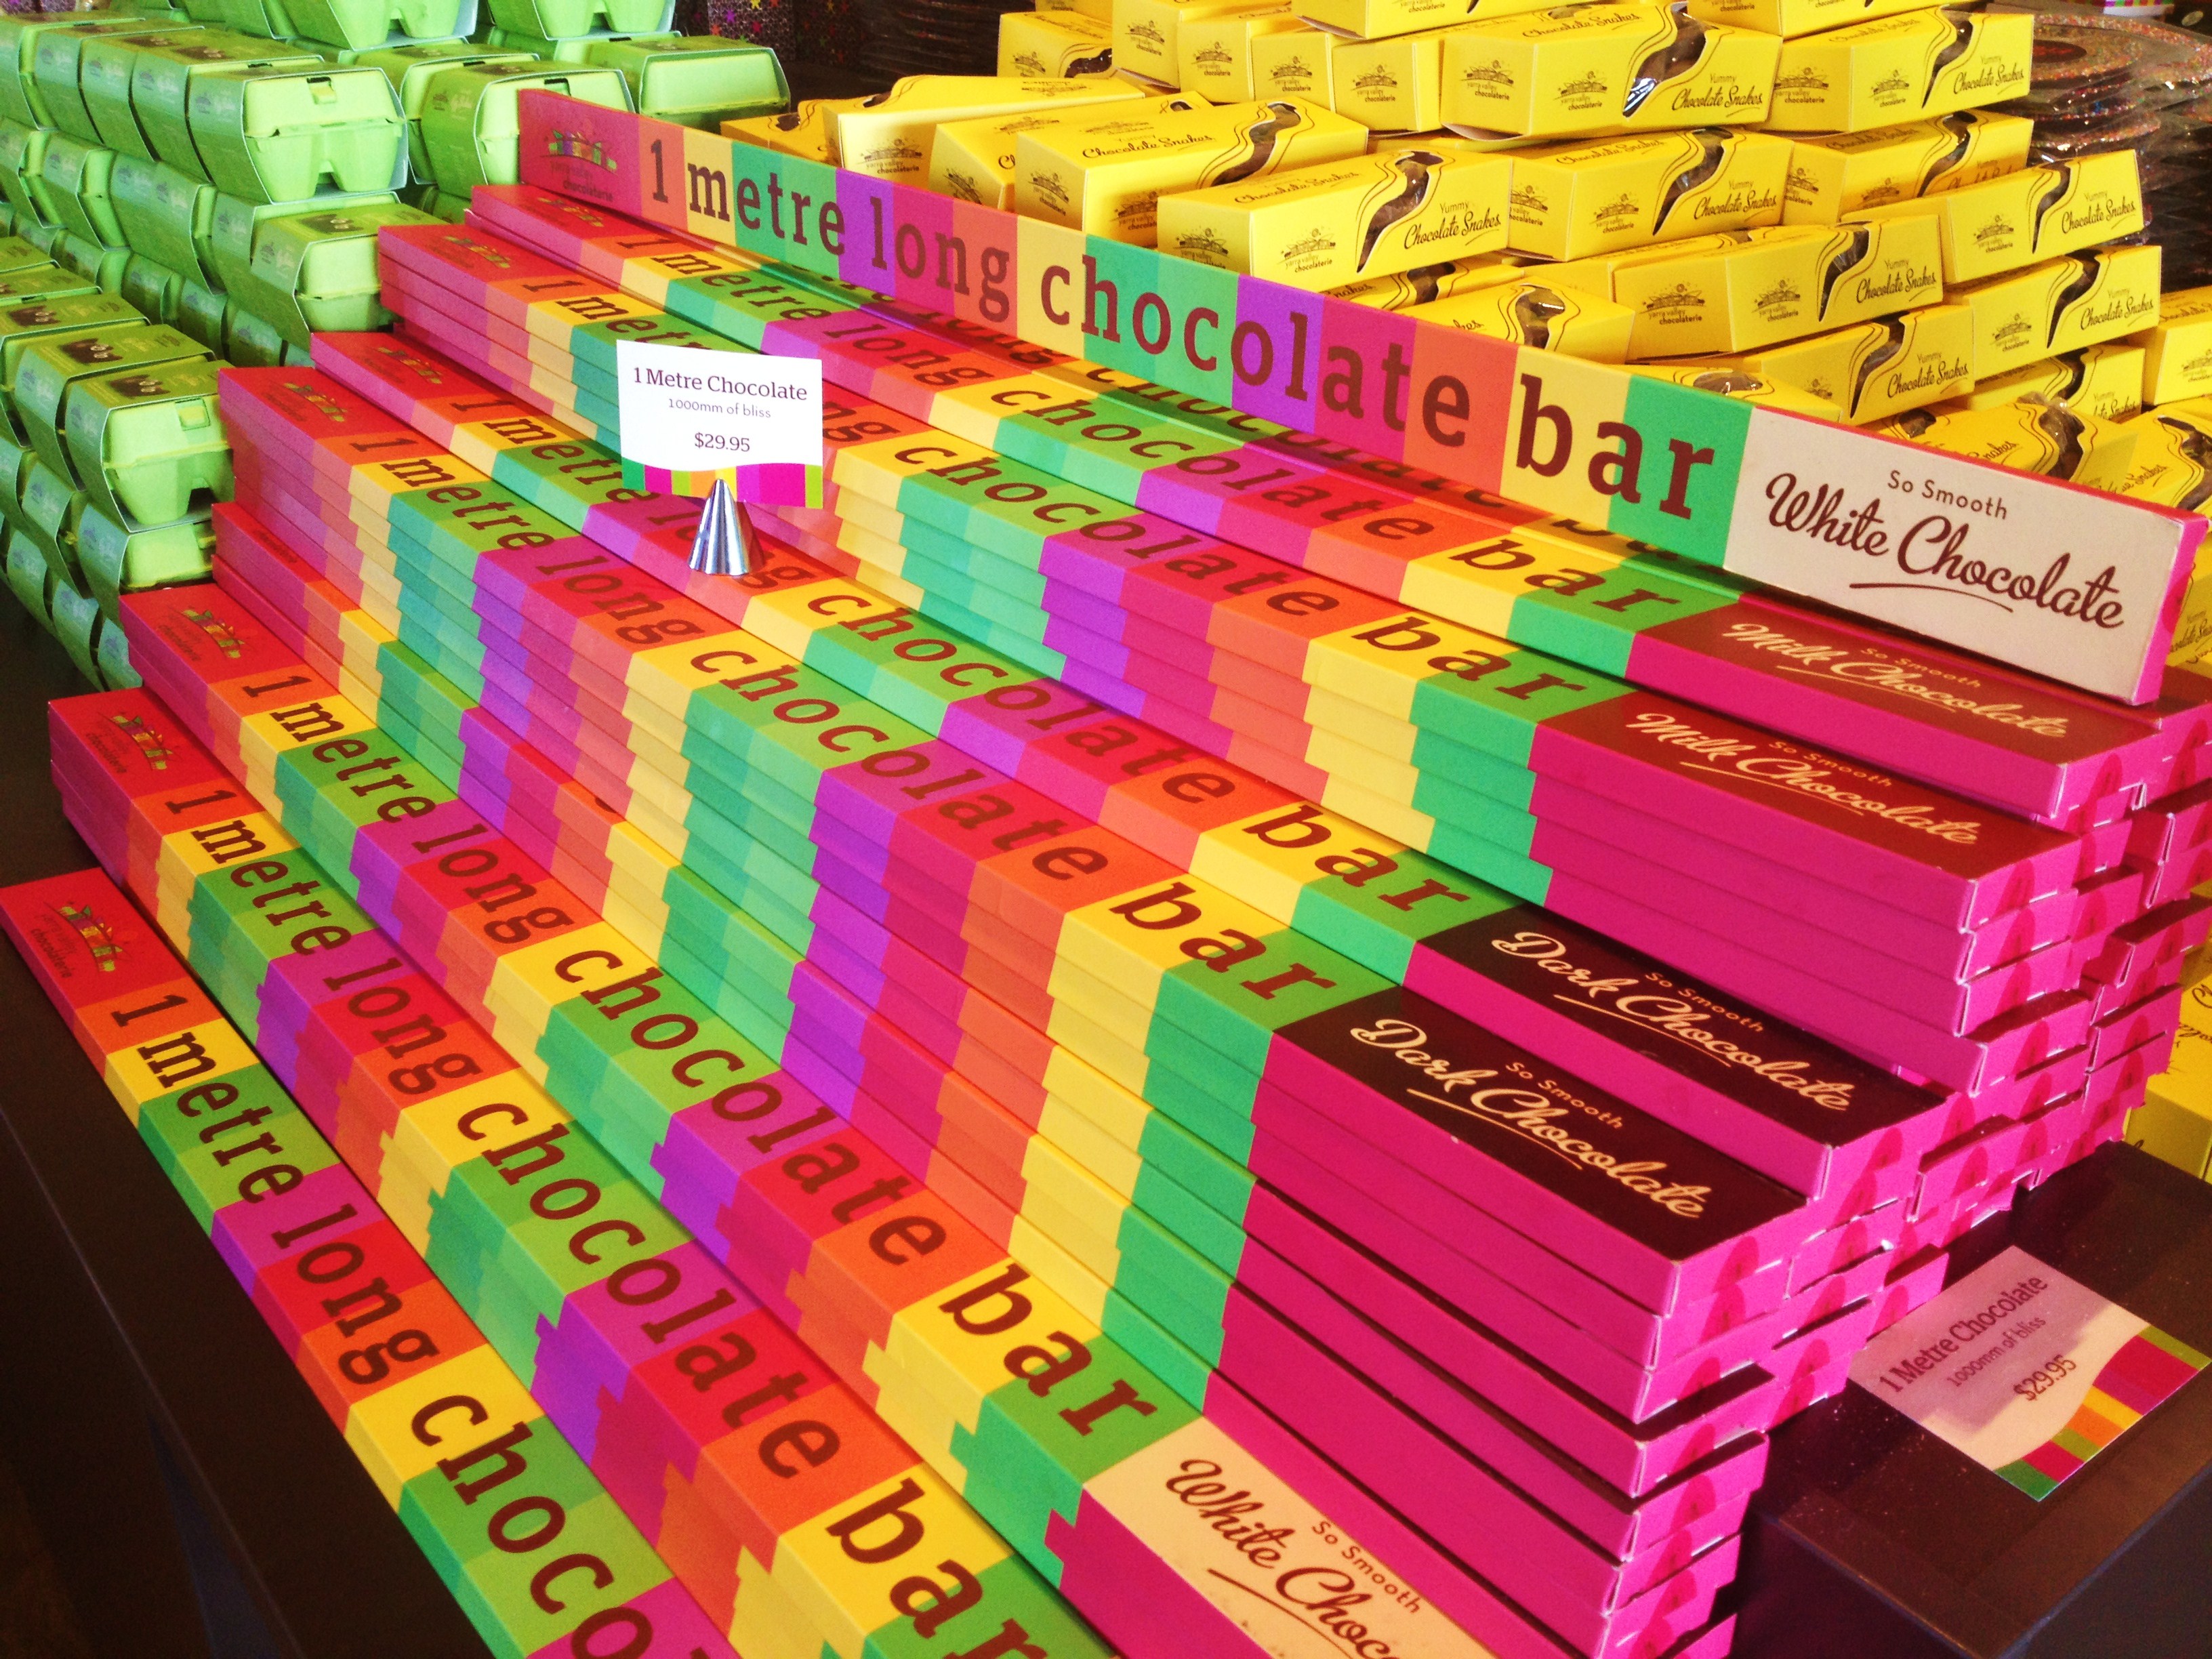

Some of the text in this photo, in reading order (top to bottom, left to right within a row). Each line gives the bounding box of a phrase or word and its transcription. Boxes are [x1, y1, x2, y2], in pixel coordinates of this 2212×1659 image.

[1408, 3, 1446, 13] chocolaterie
[1523, 12, 1643, 38] Chocolate Snakes
[1720, 3, 1755, 12] chocolaterie
[1475, 90, 1510, 101] chocolaterie
[1671, 85, 1763, 111] Chocolate Snakes
[1953, 63, 2024, 95] Chocolate Snakes
[1568, 100, 1603, 111] chocolaterie
[1082, 134, 1214, 159] Chocolate Snakes
[877, 165, 920, 175] chocolaterie
[1439, 201, 1470, 214] Yummy
[1694, 193, 1743, 220] Chocolate
[1744, 188, 1777, 213] Snakes
[2062, 196, 2136, 234] Chocolate Snakes
[2084, 190, 2108, 203] Yummy
[1404, 207, 1502, 249] Chocolate Snakes
[1602, 222, 1634, 234] chocolaterie
[1294, 258, 1333, 272] chocolaterie
[1856, 266, 1938, 304] Chocolate Snakes
[1884, 259, 1910, 270] Yummy
[651, 139, 669, 203] 1
[687, 162, 845, 255] metre
[871, 196, 1010, 322] long
[1040, 253, 1471, 447] chocolate
[1516, 373, 1715, 520] bar
[1659, 314, 1702, 325] chocolaterie
[2081, 302, 2123, 331] Chocolate
[2124, 294, 2154, 318] Snakes
[1887, 357, 1969, 398] Chocolate Snakes
[1917, 352, 1942, 365] Yummy
[634, 367, 809, 402] 1 Metre Chocolate
[617, 238, 675, 249] 1
[653, 251, 832, 322] metre
[823, 324, 996, 386] long
[991, 390, 1435, 541] chocolate
[1448, 539, 1681, 613] bar
[668, 398, 772, 419] 1000mm of bliss
[694, 432, 751, 454] $29.95
[522, 281, 582, 292] 1
[895, 447, 1340, 616] chocolate
[1351, 616, 1588, 700] bar
[1887, 469, 2009, 520] So Smooth
[1765, 472, 1890, 557] White
[1897, 515, 2124, 629] Chocolate
[448, 398, 514, 411] 1
[808, 594, 1235, 805] chocolate
[1241, 804, 1472, 912] bar
[1861, 648, 1982, 689] So Smooth
[1723, 623, 2070, 738] Milk Chocolate
[348, 437, 1337, 1002] 1 metre long chocolate bar
[1626, 713, 1982, 844] Milk Chocolate
[1769, 741, 1893, 788] So Smooth
[110, 994, 188, 1027] 1
[1491, 931, 1856, 1111] Dark Chocolate
[1645, 972, 1763, 1033] So Smooth
[242, 675, 1158, 1437] 1 metre long chocolate bar
[1504, 1061, 1625, 1130] So Smooth
[138, 1031, 305, 1205] metre
[1349, 1019, 1712, 1219] Dark Chocolate
[165, 790, 1049, 1659] 1 metre long chocolate bar
[271, 1204, 441, 1385] long
[1879, 1274, 2049, 1393] 1 Metre Chocolate
[1947, 1315, 2047, 1388] 1000mm of bliss
[2013, 1353, 2077, 1402] $29.95
[1166, 1459, 1400, 1659] White Choc
[1311, 1520, 1422, 1614] So Smooth
